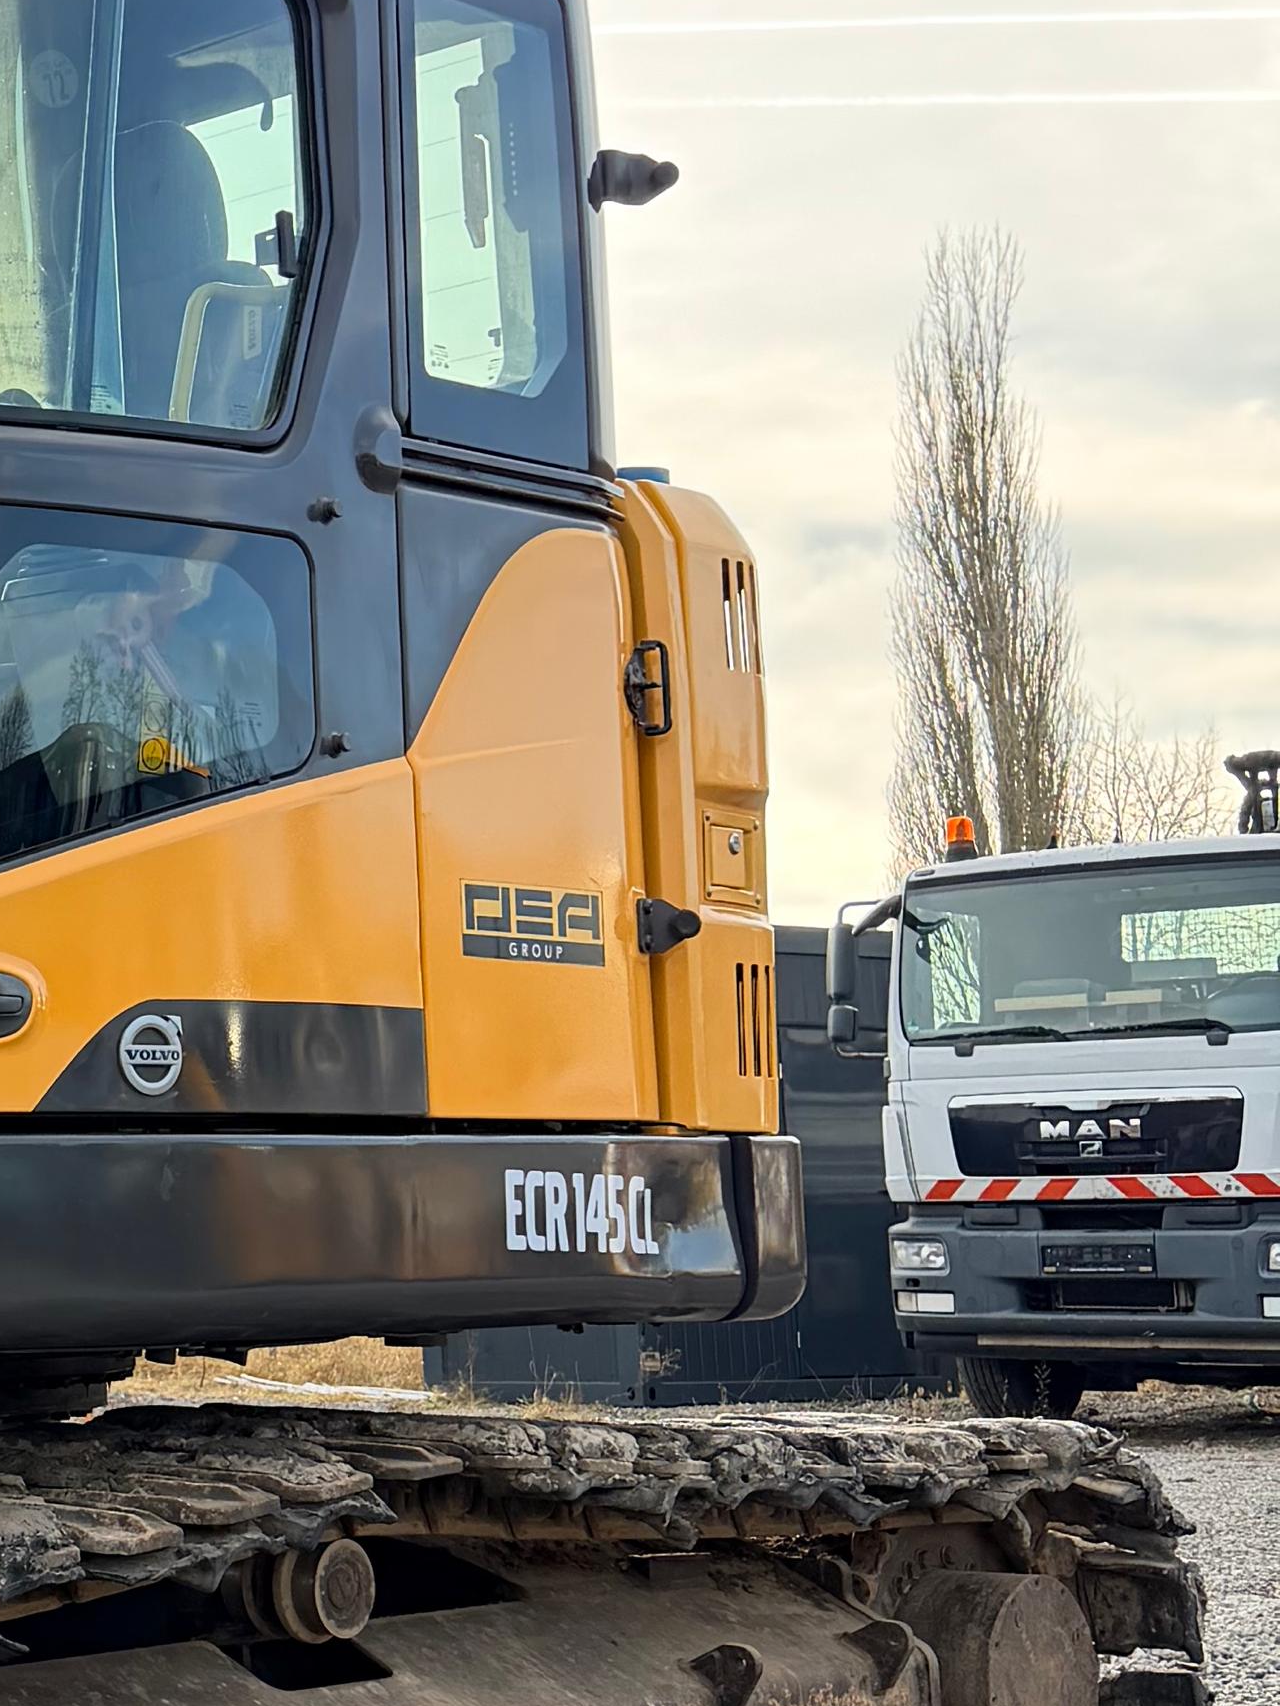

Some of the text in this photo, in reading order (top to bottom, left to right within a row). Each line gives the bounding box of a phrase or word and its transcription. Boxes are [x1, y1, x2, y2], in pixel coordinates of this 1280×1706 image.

[508, 942, 564, 959] GROUP
[124, 1049, 180, 1061] VOLVO
[1040, 1118, 1141, 1141] MAN
